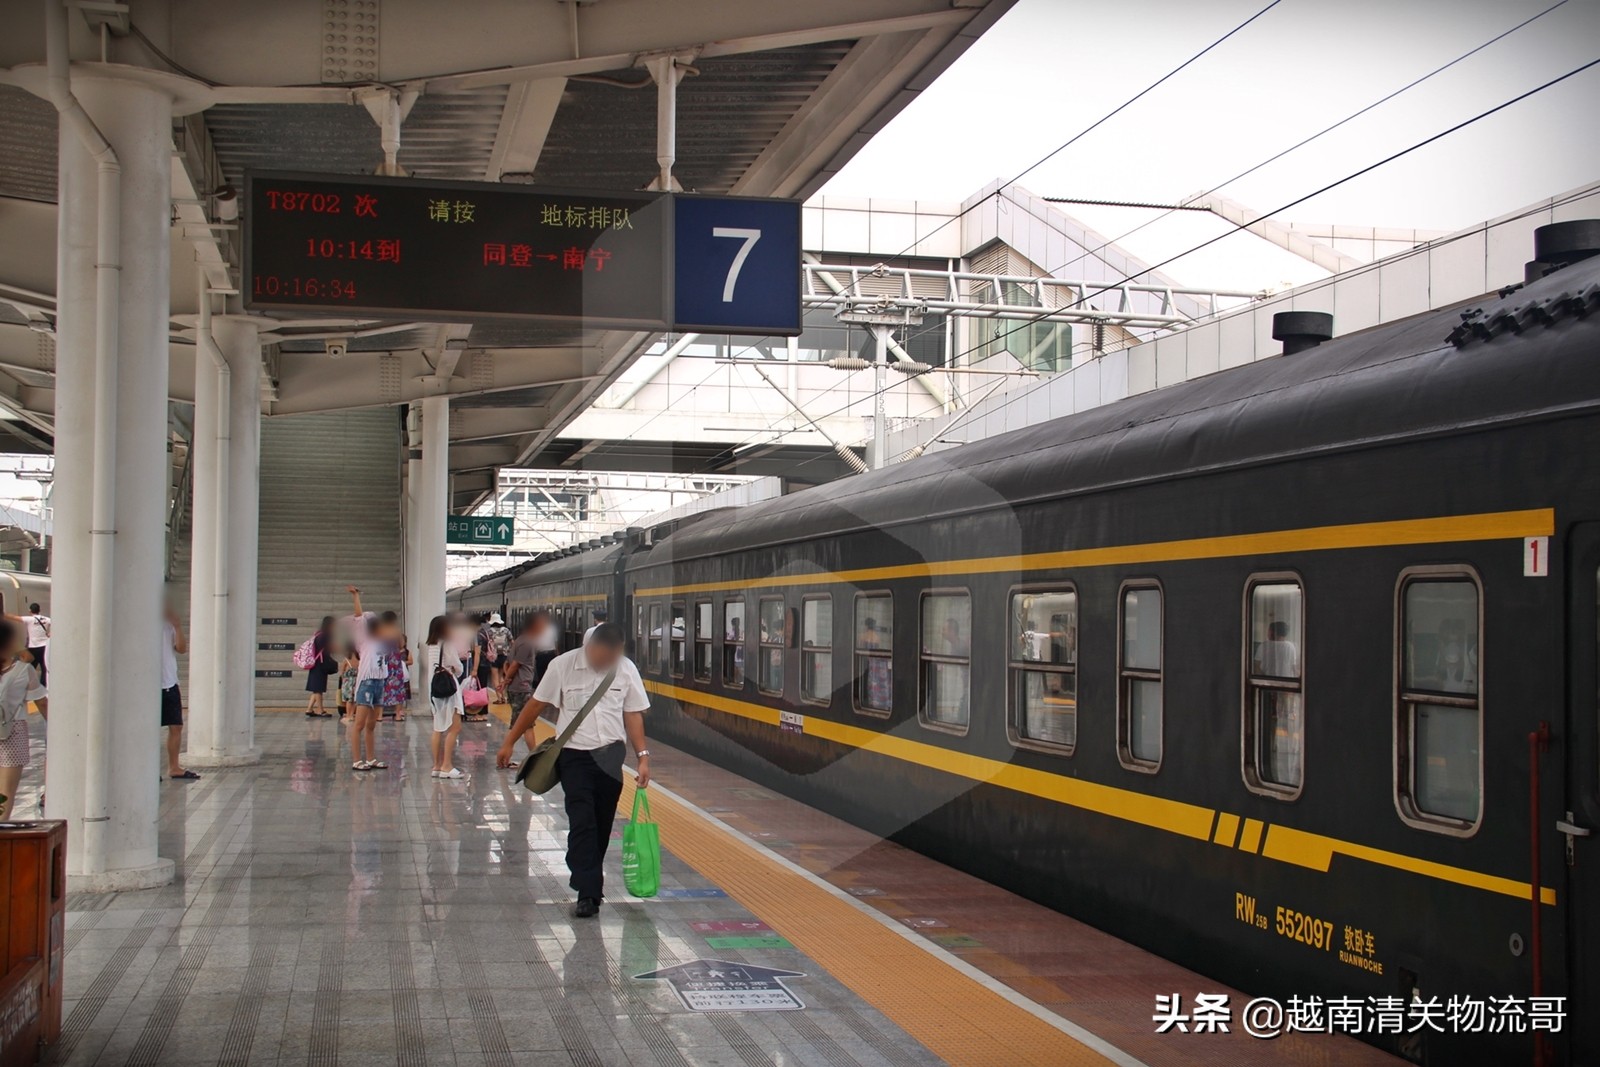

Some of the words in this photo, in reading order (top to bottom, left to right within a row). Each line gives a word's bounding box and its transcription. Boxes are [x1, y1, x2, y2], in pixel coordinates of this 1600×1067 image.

[266, 191, 341, 214] T8702
[353, 194, 378, 218] 次
[428, 199, 476, 224] 请按
[540, 204, 634, 231] 地标排队
[306, 238, 401, 264] 10:14到
[711, 226, 762, 303] 7
[253, 276, 357, 299] 10:16:34
[1531, 540, 1538, 573] 1
[1275, 905, 1334, 952] 552097
[1343, 924, 1376, 958] 软卧车
[1338, 949, 1384, 976] RUANWOCHE
